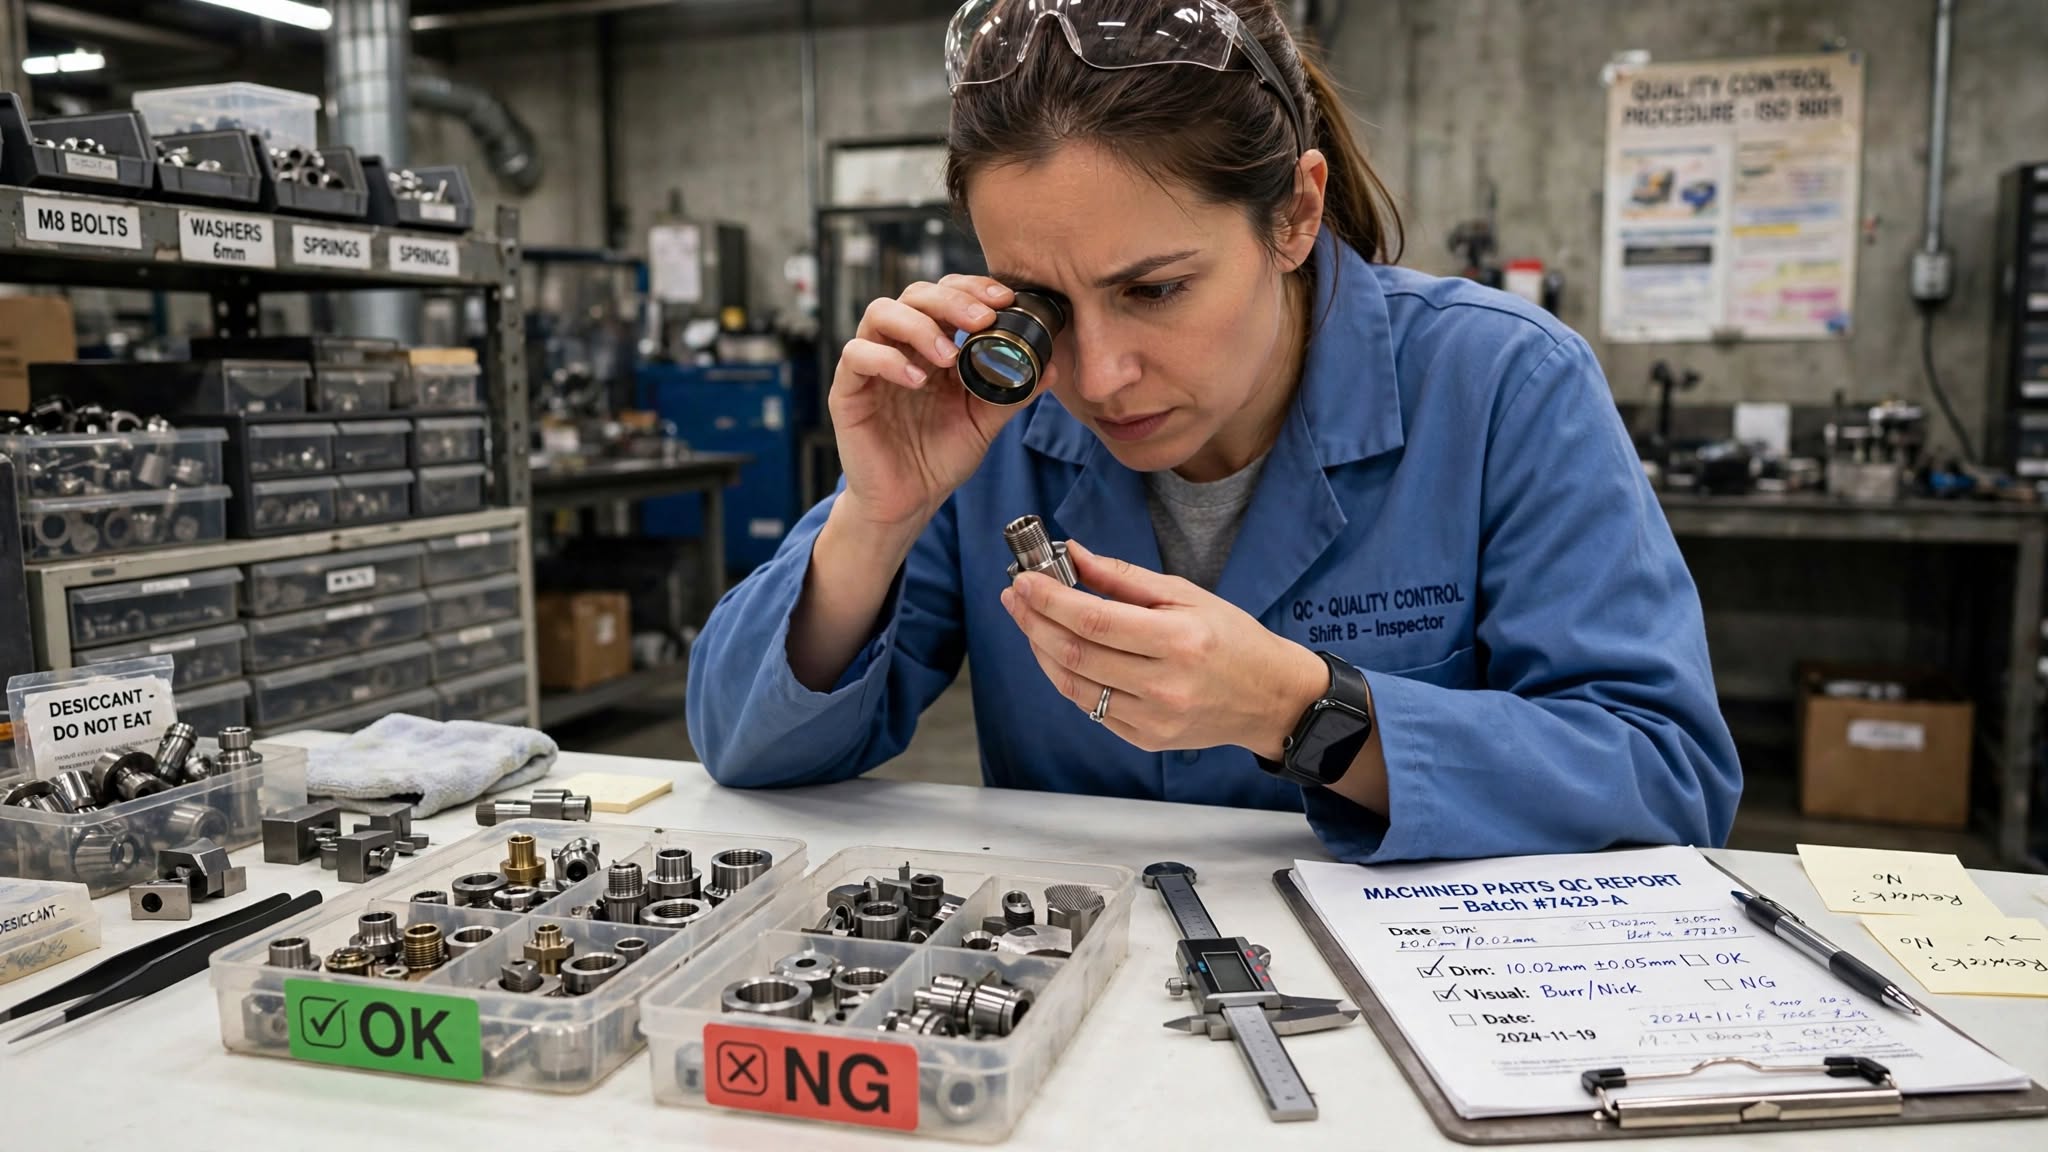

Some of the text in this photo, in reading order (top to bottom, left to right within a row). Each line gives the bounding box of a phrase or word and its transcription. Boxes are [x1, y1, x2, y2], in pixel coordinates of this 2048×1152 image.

[1632, 68, 1834, 101] QUALITY CONTROL
[1622, 104, 1734, 126] PROCEDURE
[1755, 102, 1790, 121] ISO
[38, 208, 128, 237] M8 BOLTS
[190, 217, 262, 242] WASHERS
[213, 242, 246, 261] 6mm
[303, 236, 361, 259] SPRINGS
[400, 245, 450, 267] SPRINGS
[1293, 600, 1313, 621] QC
[1328, 592, 1388, 618] QUALITY
[1394, 582, 1464, 609] CONTROL
[1309, 624, 1342, 643] Shift
[1347, 622, 1358, 639] B
[1376, 614, 1445, 638] Inspector
[49, 688, 143, 718] DESICCANT
[53, 710, 152, 741] DO NOT EAT
[1363, 874, 1682, 900] MACHINED PARTS QC REPORT
[1872, 873, 1902, 885] No
[1463, 898, 1528, 913] Batch
[1533, 894, 1628, 910] #7429-A
[1388, 927, 1432, 936] Date
[1900, 937, 1934, 949] No
[1449, 965, 1496, 977] Dim:
[1506, 962, 1587, 975] 10.02mm
[1715, 952, 1750, 965] OK
[1464, 986, 1531, 1001] Visual:
[1739, 975, 1776, 990] NG
[1482, 1013, 1536, 1026] Date:
[358, 1000, 456, 1066] OK
[1496, 1028, 1597, 1045] 2024-11-19
[784, 1046, 890, 1114] NG
